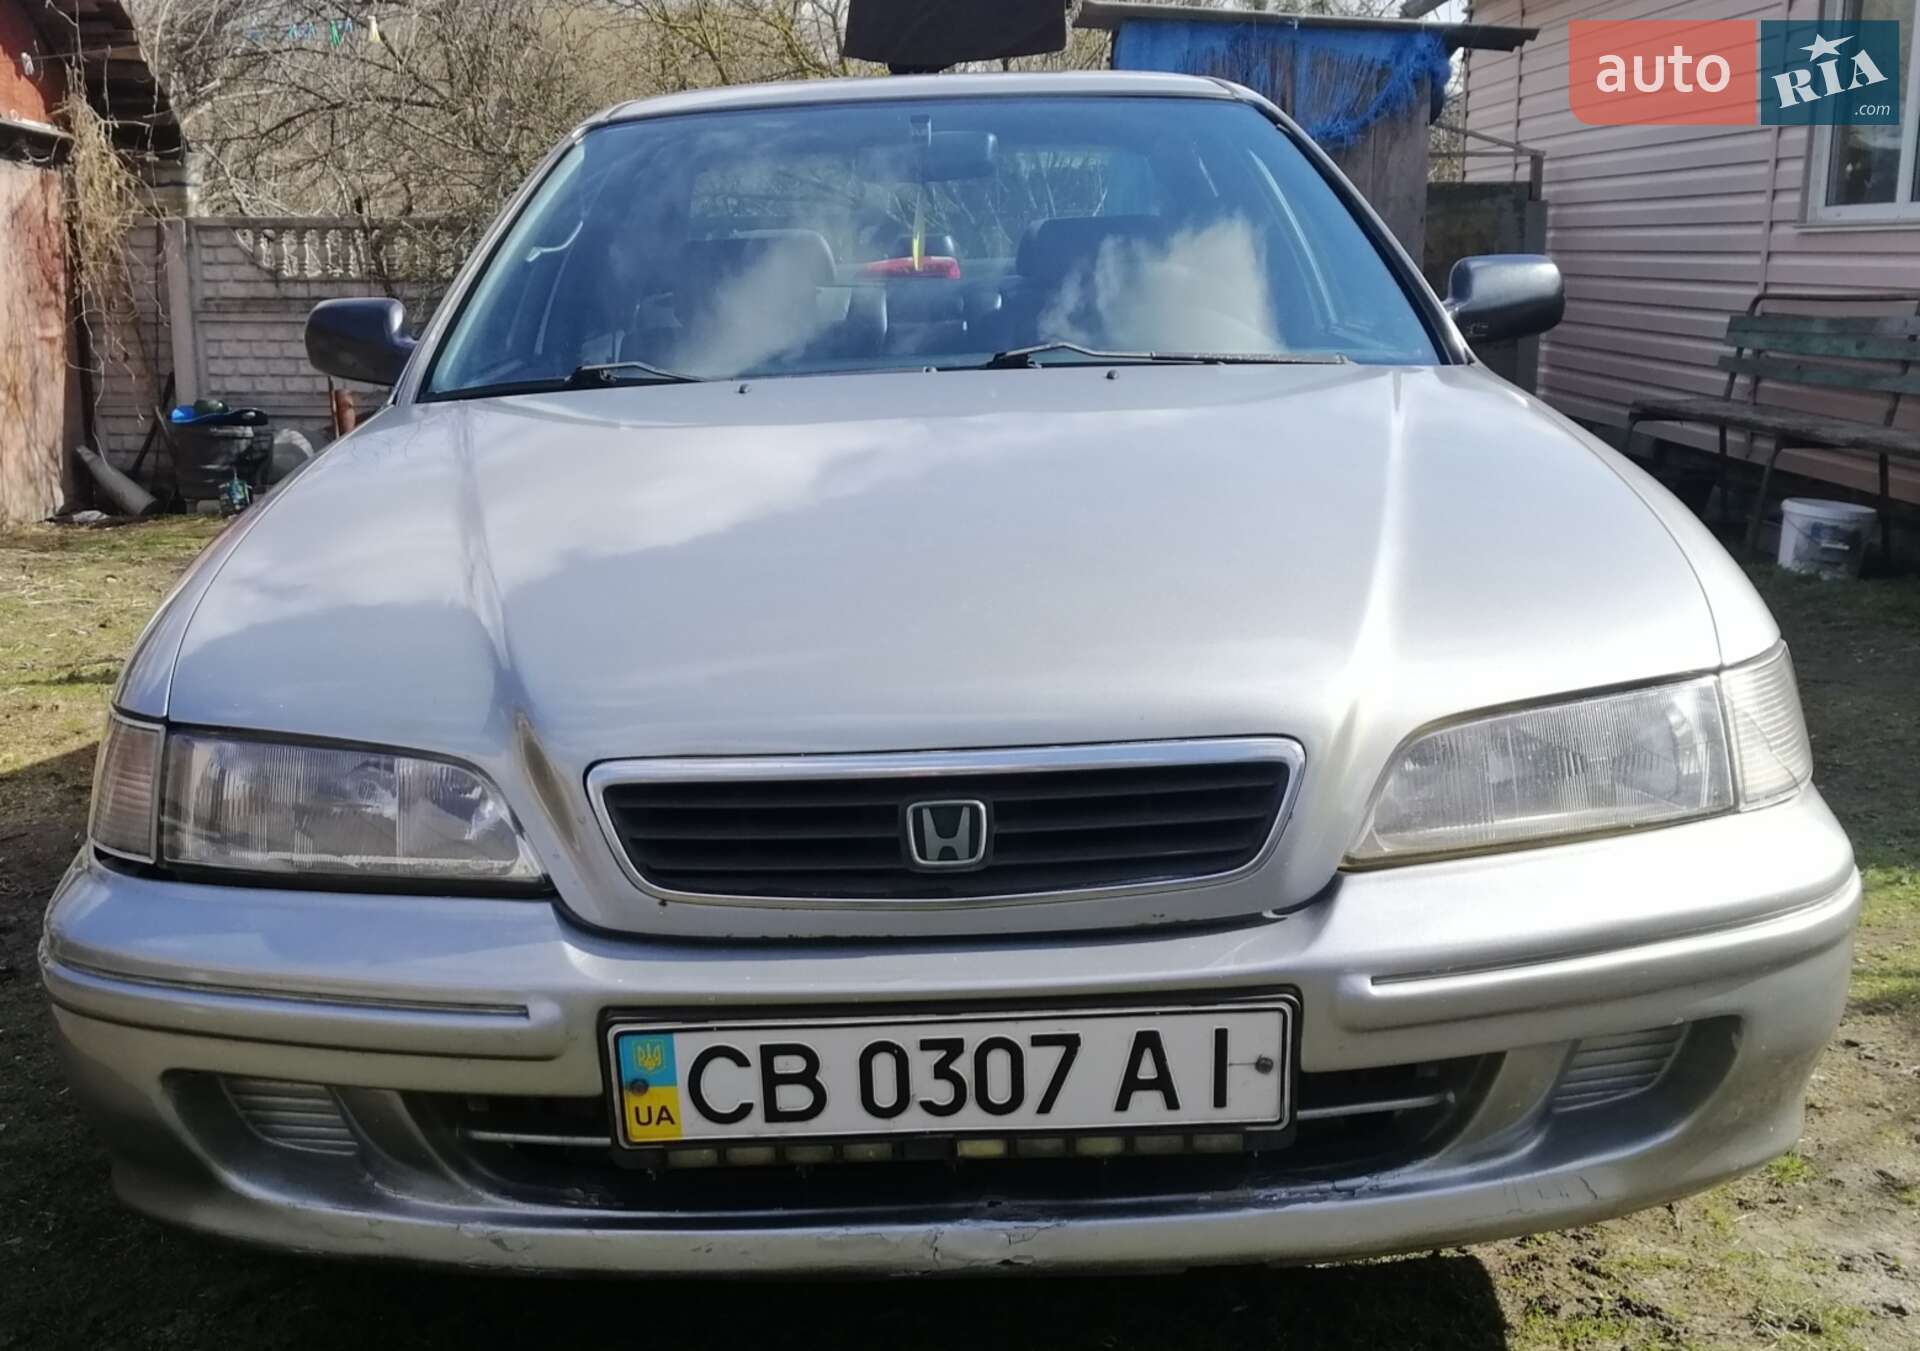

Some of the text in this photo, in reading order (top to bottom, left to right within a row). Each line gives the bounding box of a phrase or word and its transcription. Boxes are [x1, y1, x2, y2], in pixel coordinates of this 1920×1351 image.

[687, 1042, 828, 1124] CB
[858, 1032, 1081, 1119] 0307
[635, 1104, 676, 1127] UA
